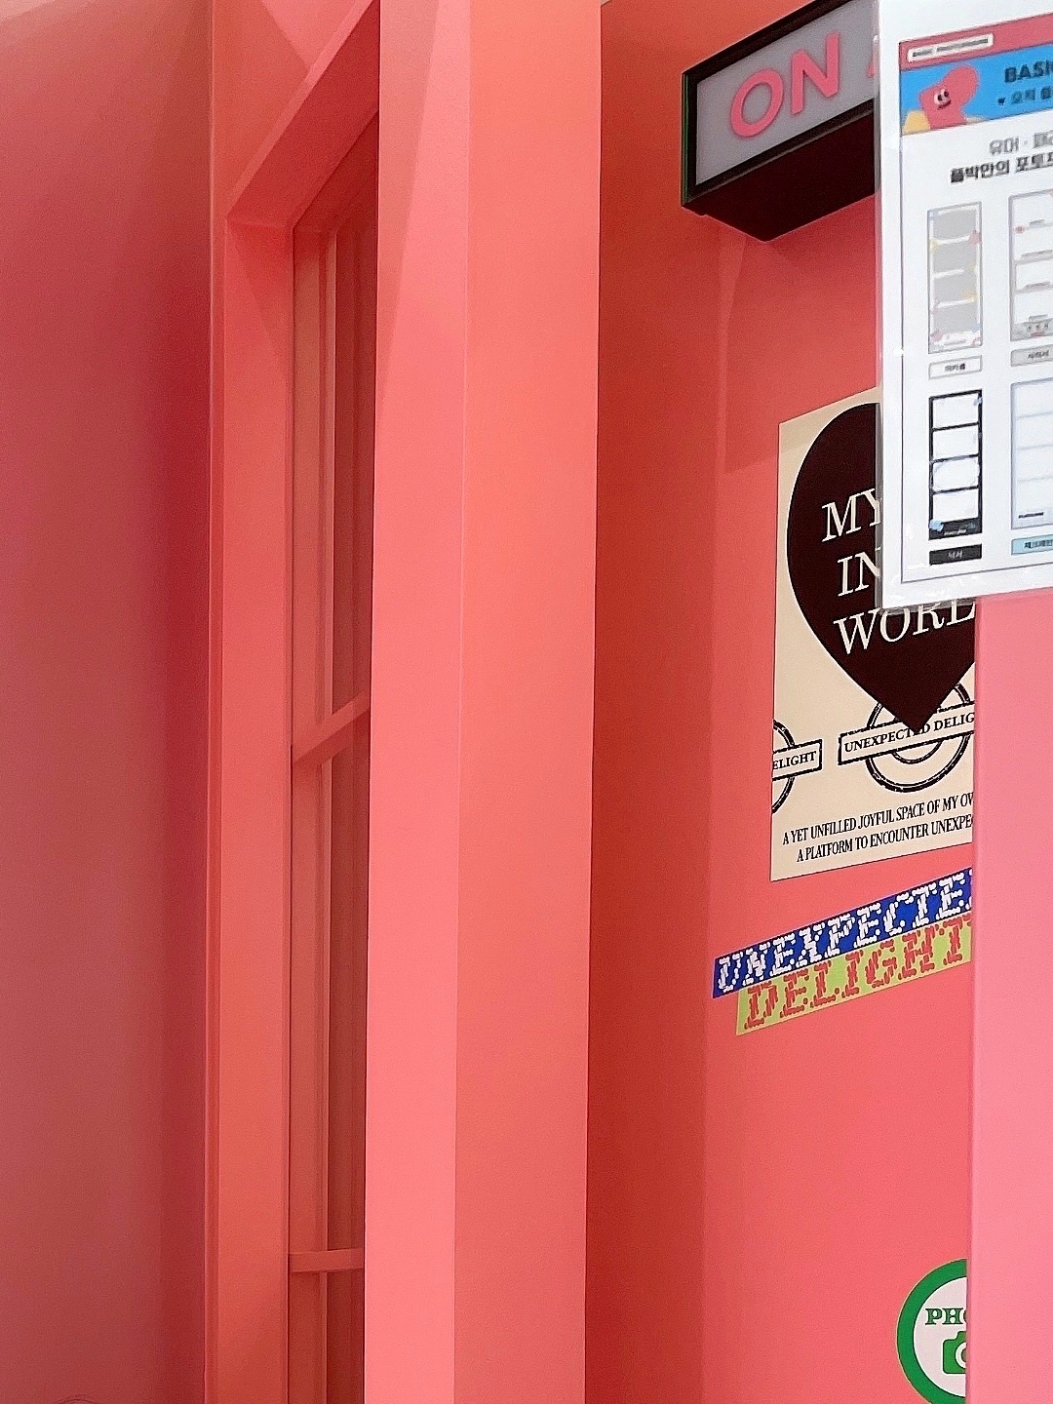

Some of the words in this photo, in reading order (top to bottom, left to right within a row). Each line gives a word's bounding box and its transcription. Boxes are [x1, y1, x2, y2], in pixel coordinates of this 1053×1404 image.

[730, 31, 840, 139] ON
[844, 723, 931, 753] UNEXPECTD
[783, 832, 790, 846] A
[791, 827, 809, 843] YET
[811, 817, 857, 839] UNFILLED
[858, 809, 895, 830] JOYFUL
[896, 802, 925, 822] SPACE
[927, 799, 941, 814] OF
[942, 795, 959, 812] MY
[797, 848, 804, 863] A
[805, 838, 853, 861] PLATFORM
[855, 835, 869, 850] TO
[870, 823, 929, 848] ENCOUNTER
[717, 868, 973, 993] UNEXPECTE
[924, 1307, 967, 1326] PH
